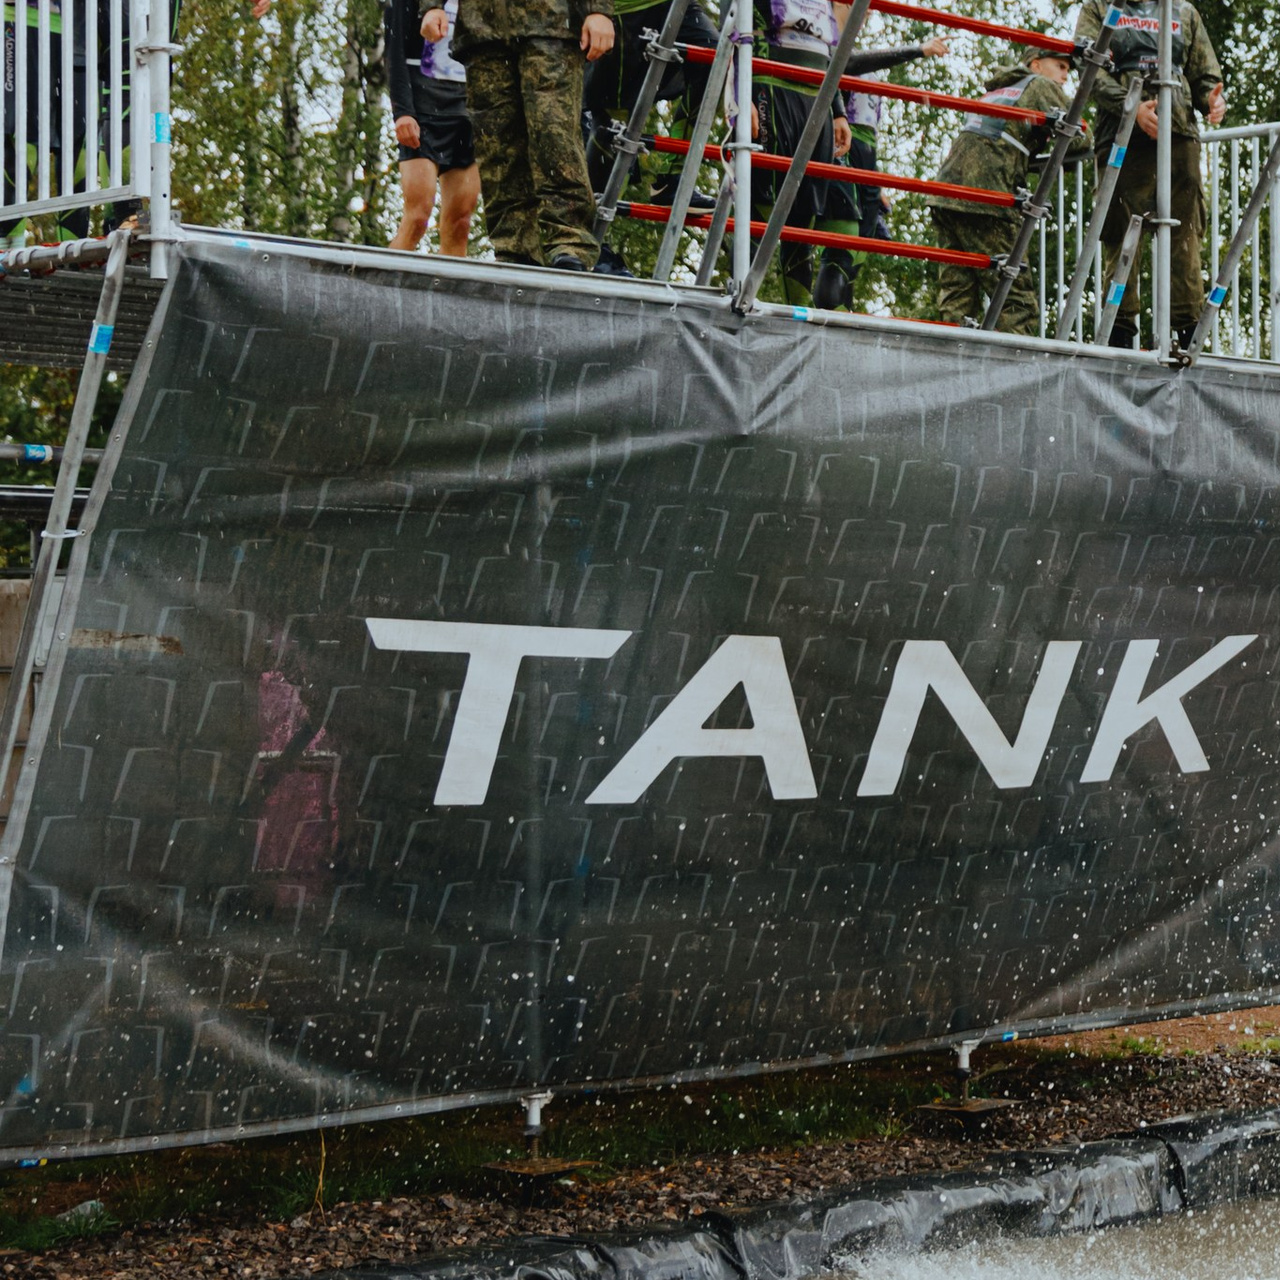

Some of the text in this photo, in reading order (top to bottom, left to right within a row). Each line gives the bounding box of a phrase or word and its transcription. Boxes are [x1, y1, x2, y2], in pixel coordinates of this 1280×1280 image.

[4, 34, 15, 92] Greenway
[757, 99, 768, 153] reenway
[365, 617, 1259, 805] TANK
